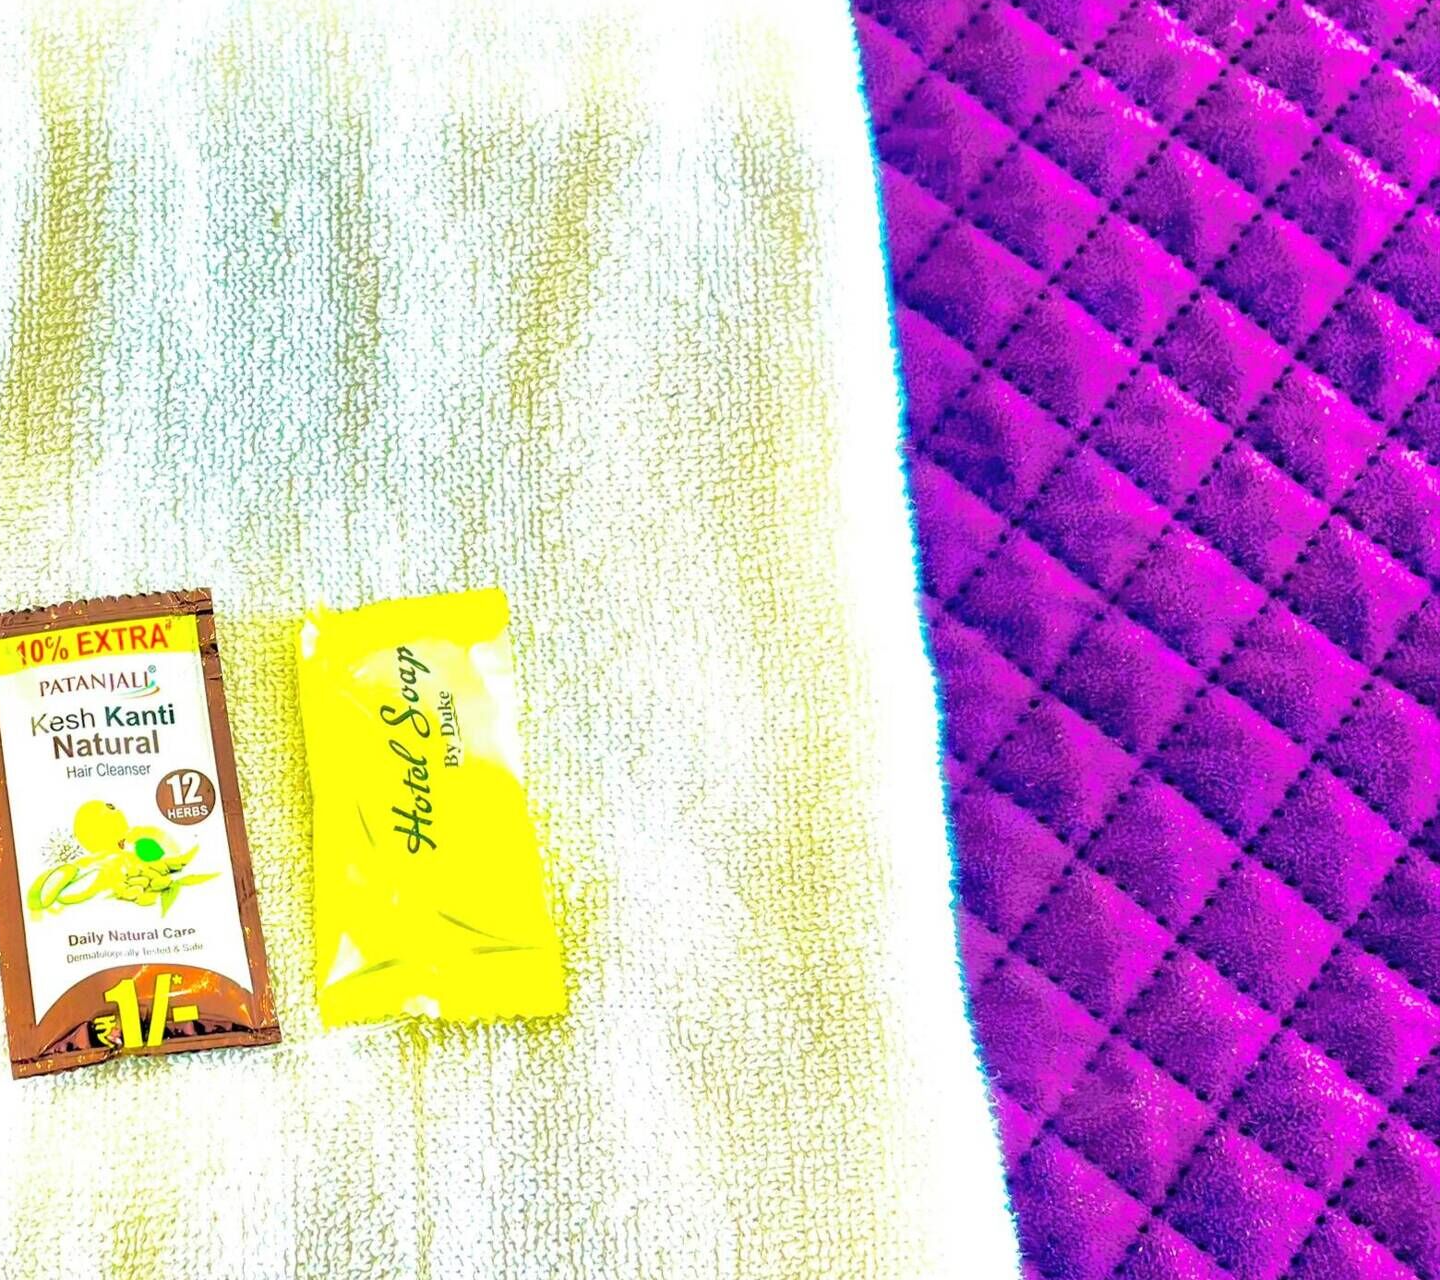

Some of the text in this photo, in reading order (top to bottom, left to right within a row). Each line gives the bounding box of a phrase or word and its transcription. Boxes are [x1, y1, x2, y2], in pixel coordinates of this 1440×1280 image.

[16, 635, 69, 665] 10%
[31, 704, 176, 737] Kesh Kanti
[437, 690, 461, 769] By Duke
[52, 729, 160, 760] Natural
[380, 645, 437, 854] Hotel Soap
[66, 762, 152, 780] Hair Cleanser
[166, 771, 203, 806] 12
[167, 805, 209, 819] HERBS
[68, 931, 104, 946] Daily
[108, 928, 159, 942] Natural
